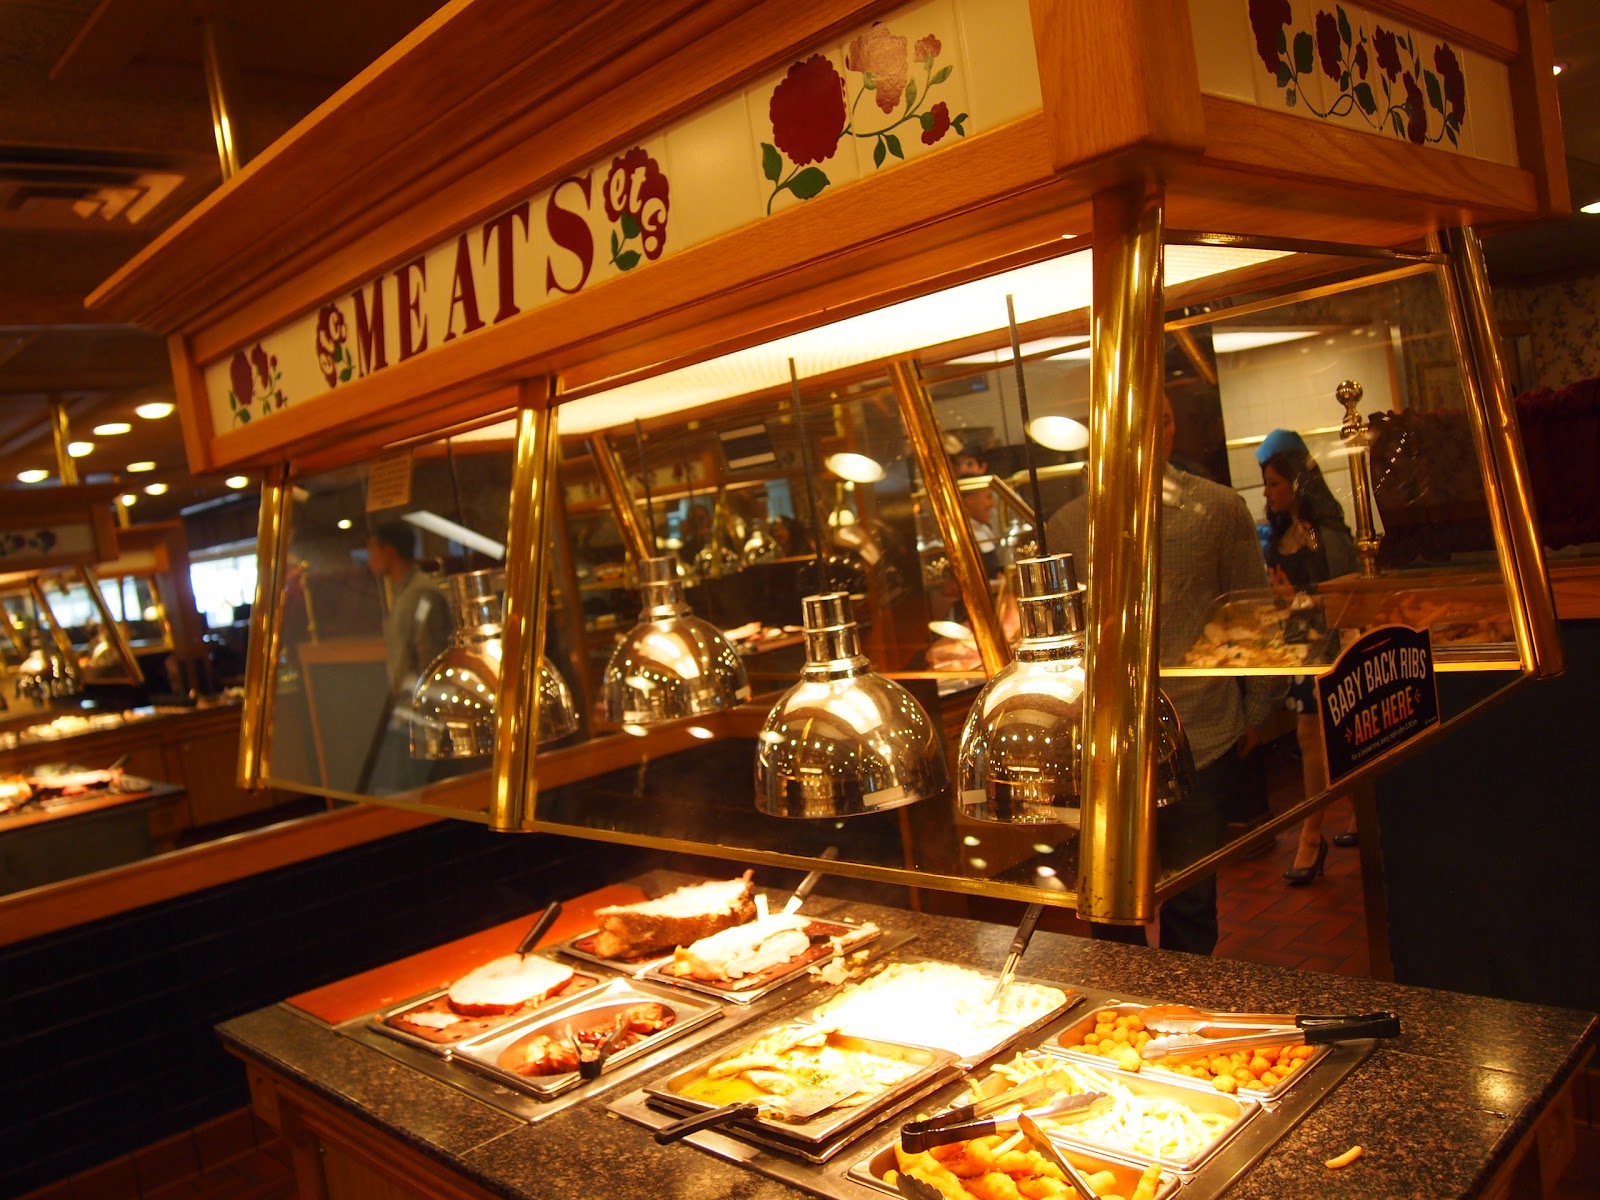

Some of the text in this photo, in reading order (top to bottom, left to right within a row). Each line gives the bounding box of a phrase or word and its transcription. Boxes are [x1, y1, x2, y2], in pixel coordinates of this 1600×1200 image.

[351, 168, 595, 378] MEATS
[1327, 647, 1427, 727] BABY BACK RIBS
[1354, 685, 1415, 745] ARE HERE
